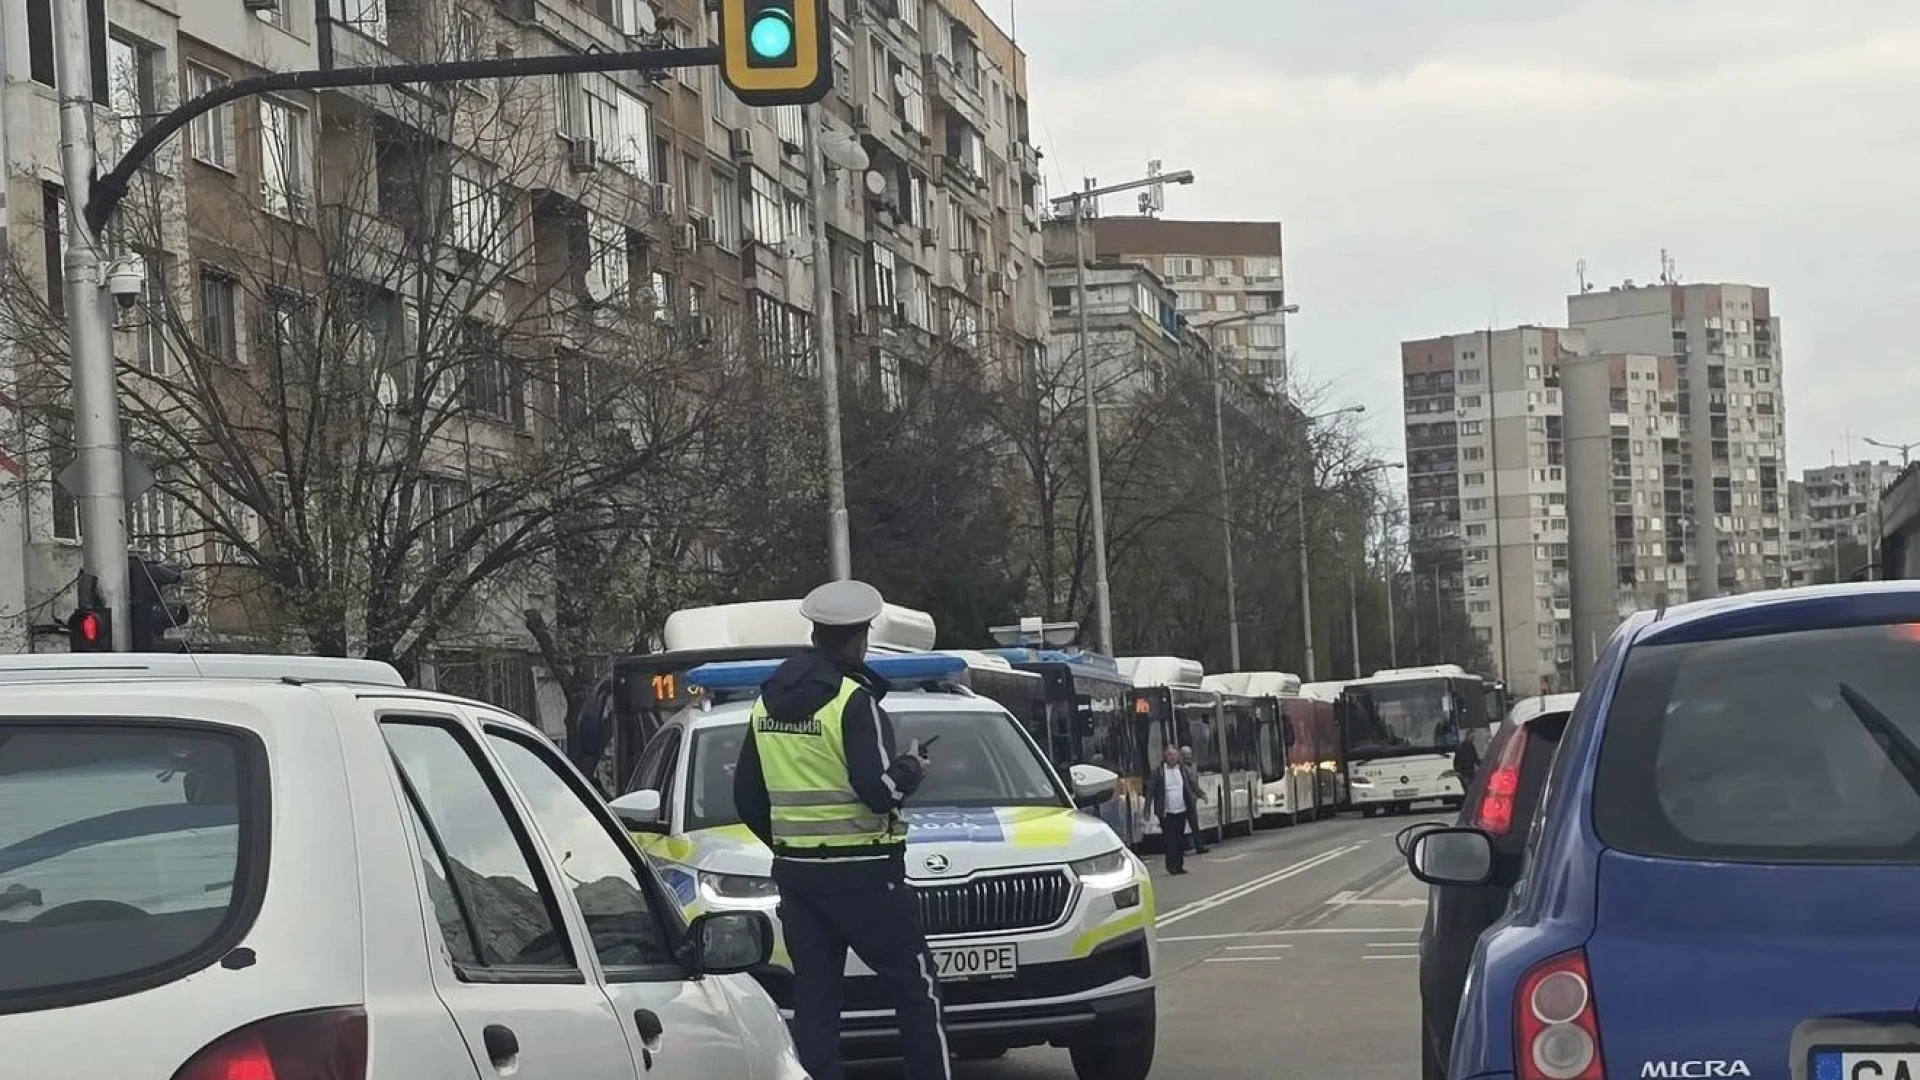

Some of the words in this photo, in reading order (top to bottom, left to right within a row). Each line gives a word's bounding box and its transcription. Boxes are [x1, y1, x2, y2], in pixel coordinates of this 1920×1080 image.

[652, 674, 674, 699] 11
[984, 948, 1013, 970] PE
[1640, 1060, 1751, 1078] MICRA
